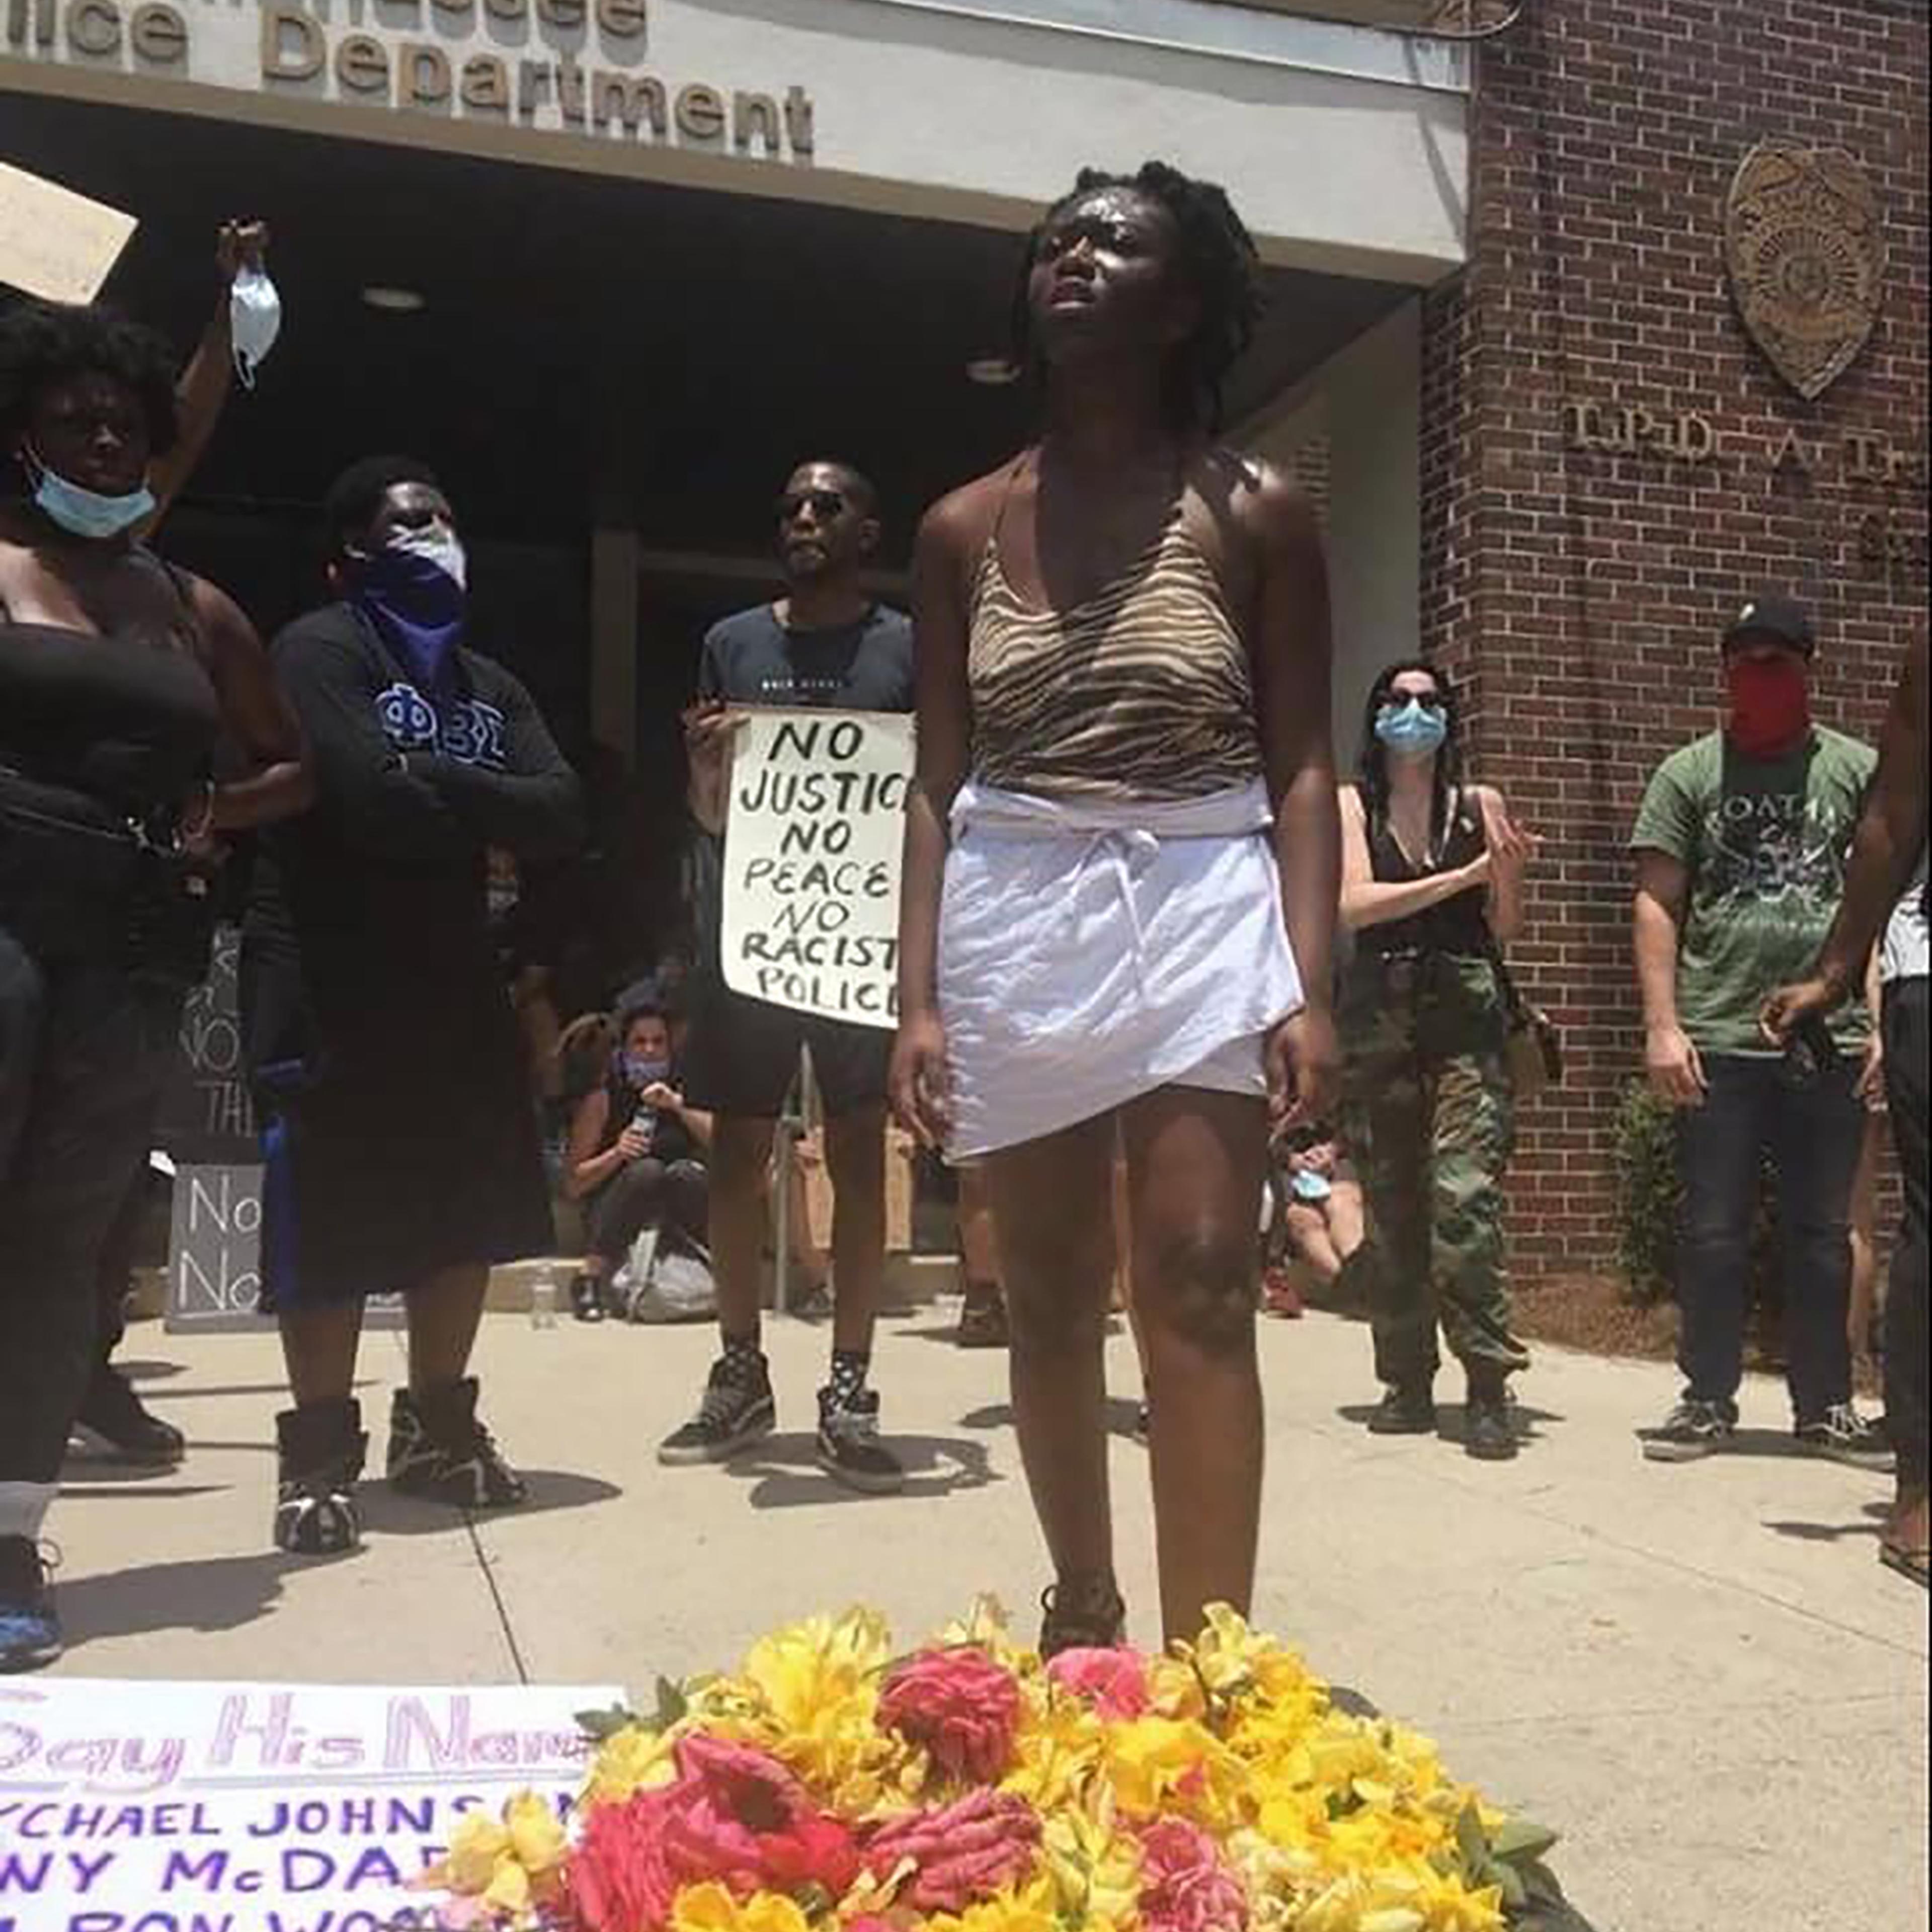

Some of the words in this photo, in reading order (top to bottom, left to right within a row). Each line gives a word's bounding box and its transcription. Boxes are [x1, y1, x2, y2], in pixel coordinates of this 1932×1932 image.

[261, 4, 813, 154] Department
[768, 721, 863, 762] NO
[740, 769, 907, 815] JUSTIC
[780, 820, 852, 856] NO
[744, 858, 891, 898] PEACE
[774, 900, 850, 934] NO
[742, 932, 899, 971] RACIST
[207, 1692, 366, 1767] His
